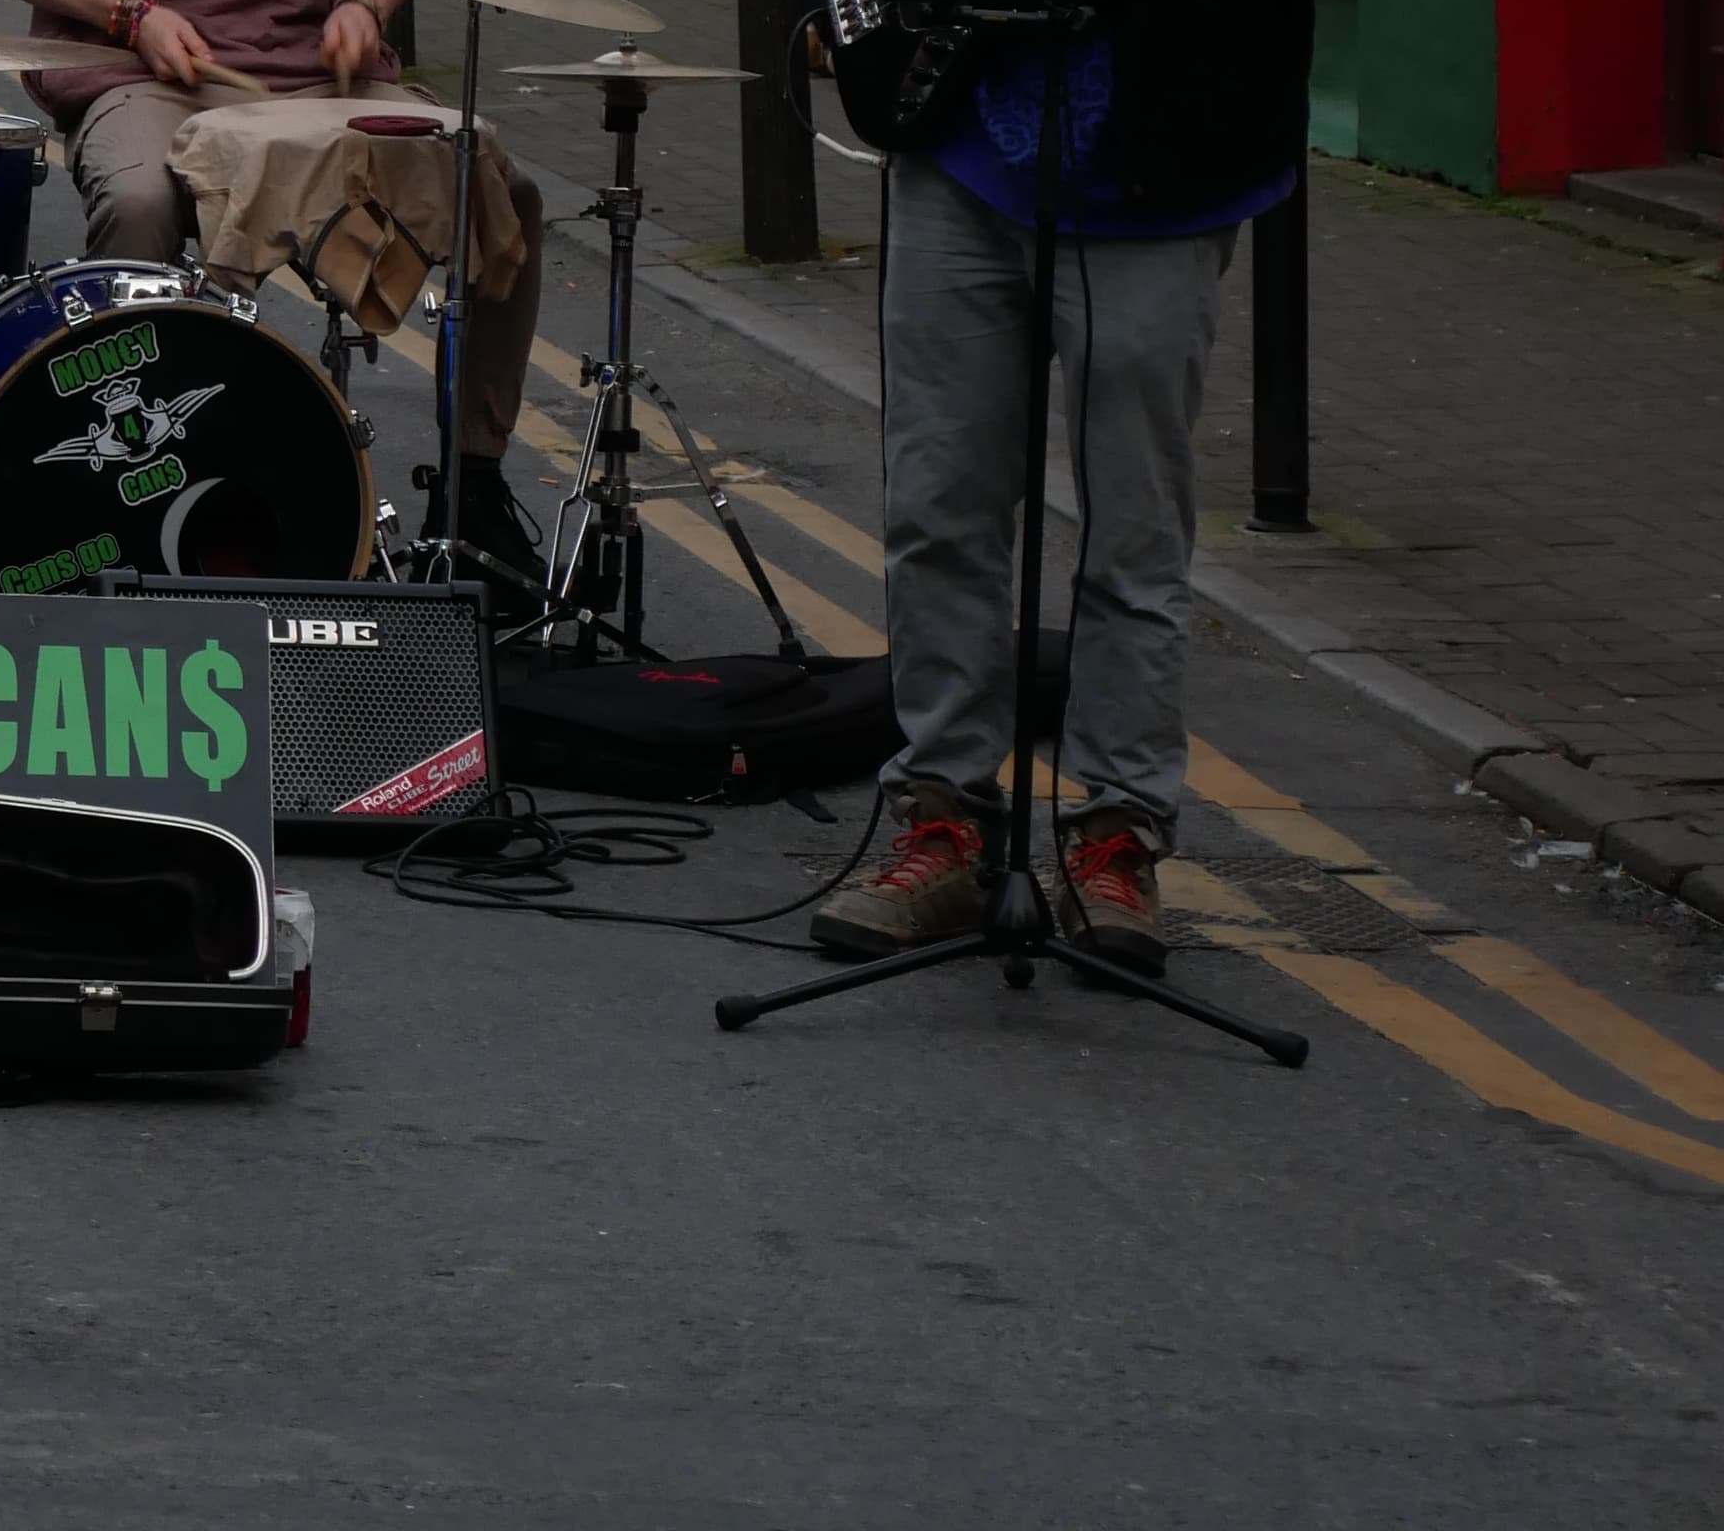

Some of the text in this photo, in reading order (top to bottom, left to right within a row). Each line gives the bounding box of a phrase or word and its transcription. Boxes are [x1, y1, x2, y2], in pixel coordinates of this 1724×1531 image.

[123, 414, 141, 441] 4
[75, 533, 120, 576] go
[268, 618, 380, 647] UBE
[427, 745, 482, 790] Street
[360, 776, 413, 812] Roland
